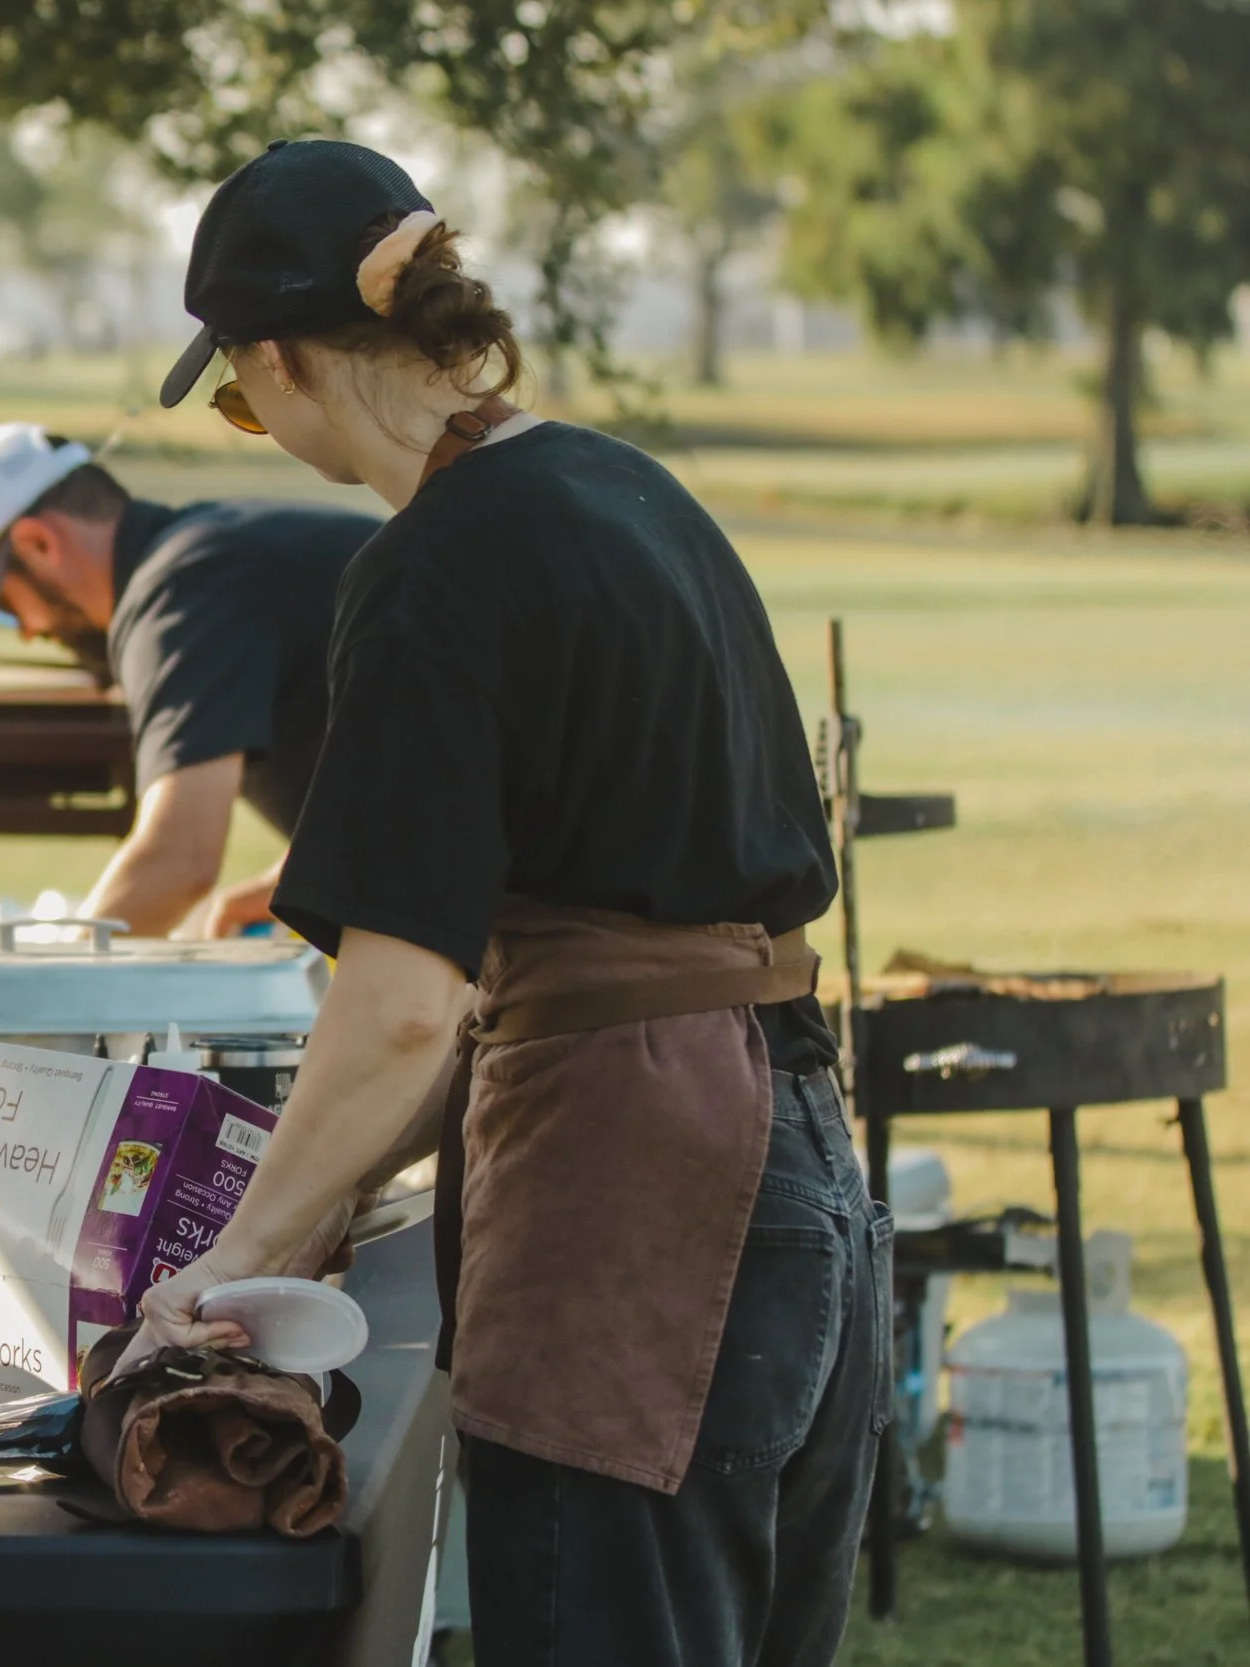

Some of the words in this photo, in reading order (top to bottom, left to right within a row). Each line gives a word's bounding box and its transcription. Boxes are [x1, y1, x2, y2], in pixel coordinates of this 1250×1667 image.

[1, 1058, 24, 1072] Strong
[30, 1064, 54, 1078] Quality
[54, 1068, 84, 1082] Banquet
[221, 1159, 248, 1177] FORKS
[183, 1181, 217, 1202] Occasion
[213, 1171, 246, 1197] 500
[175, 1189, 201, 1207] Strong
[219, 1196, 232, 1209] Any
[206, 1204, 232, 1221] Quality
